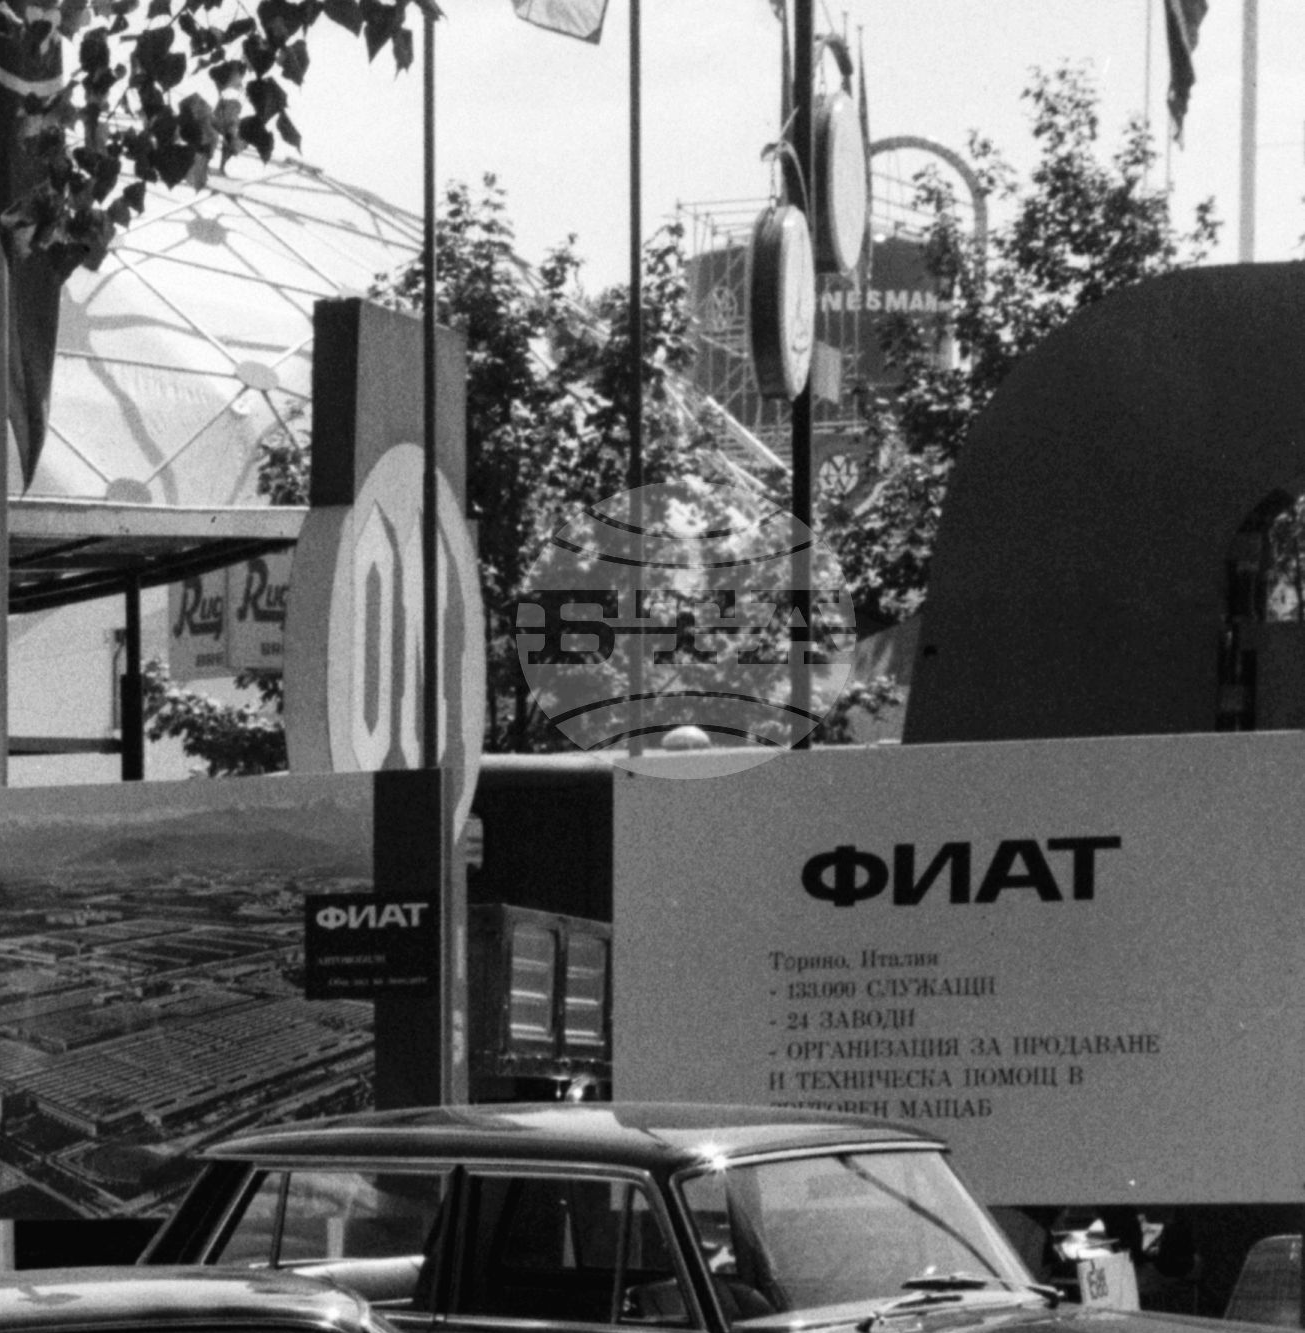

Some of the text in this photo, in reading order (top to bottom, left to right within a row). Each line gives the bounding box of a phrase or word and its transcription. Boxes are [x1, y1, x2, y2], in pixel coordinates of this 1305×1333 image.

[801, 835, 1121, 908] ФИАТ
[315, 902, 430, 930] ФИАТ
[861, 949, 939, 969] Италия
[866, 976, 995, 998] СЛУЖАЩИ
[787, 1008, 915, 1031] 24 ЗАВОДИ
[787, 1034, 1160, 1060] ОРГАНИЗАЦИЯ ЗА ПРОДАВАНЕ
[769, 1065, 1083, 1091] И ТЕХНИЧЕСКА ПОМОЩ В
[900, 1098, 991, 1119] МАЩАБ
